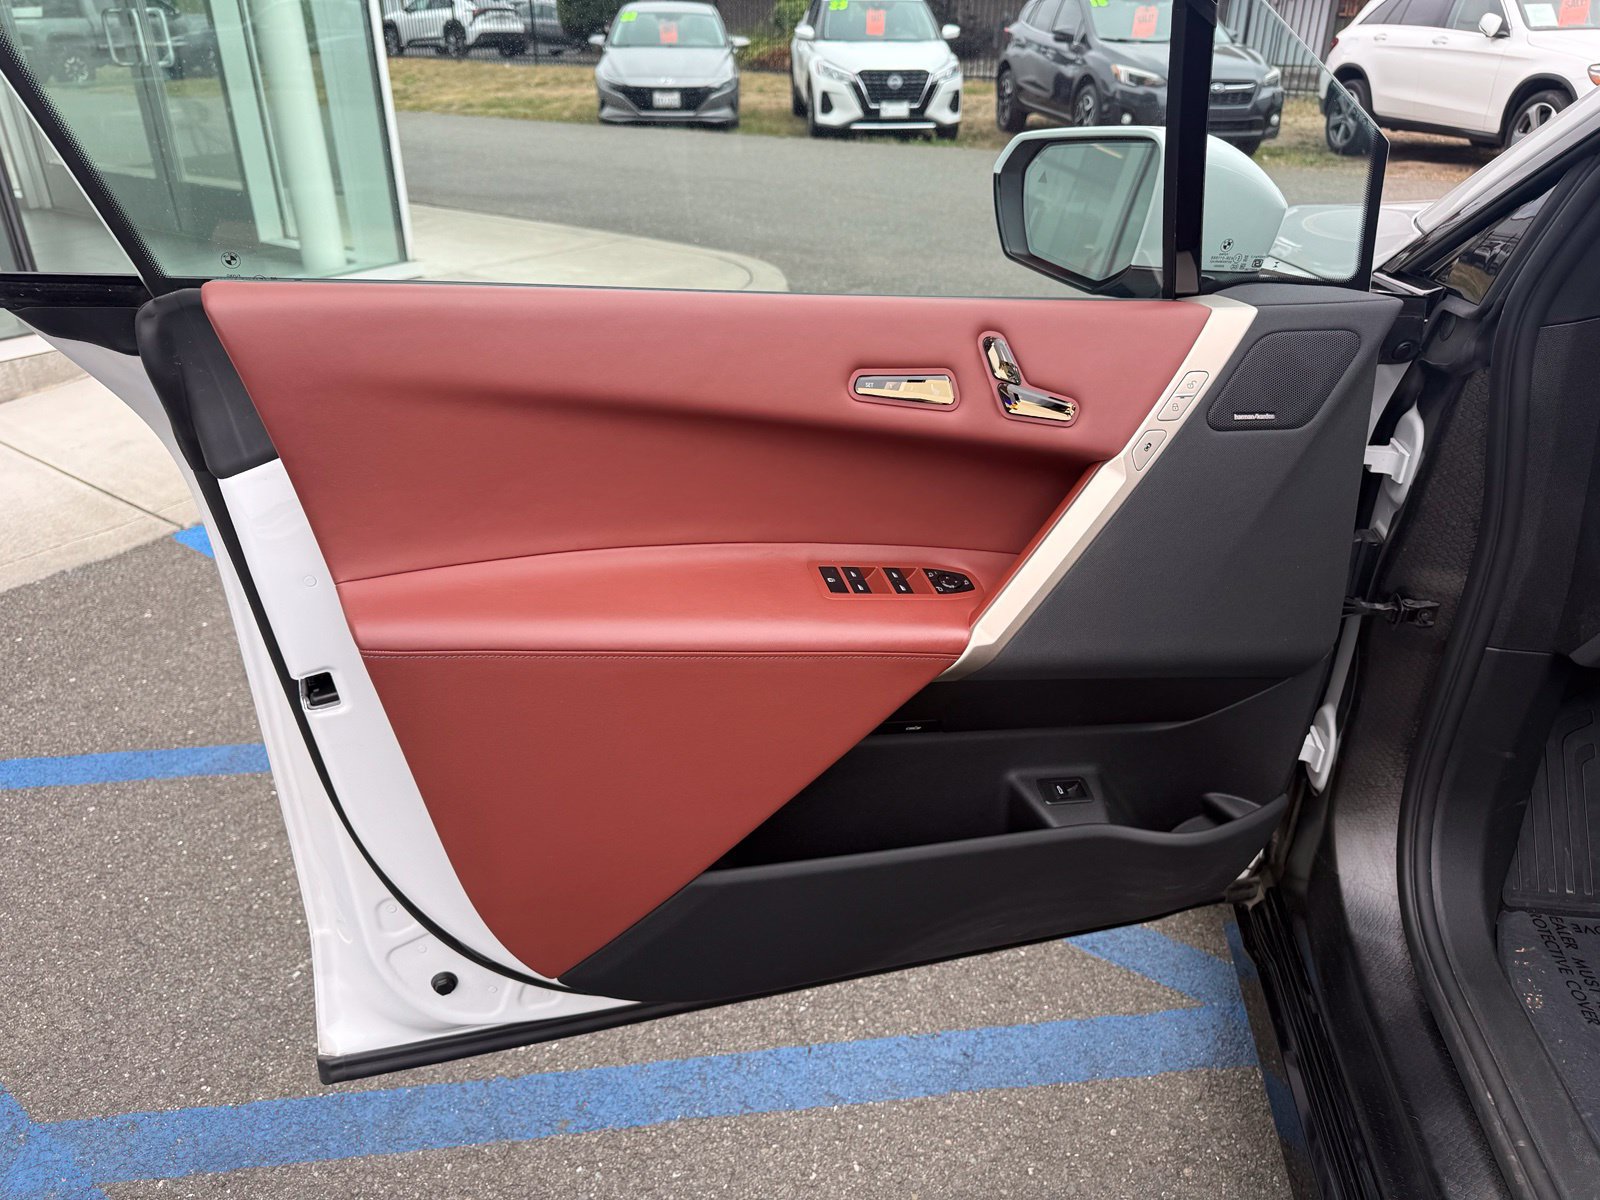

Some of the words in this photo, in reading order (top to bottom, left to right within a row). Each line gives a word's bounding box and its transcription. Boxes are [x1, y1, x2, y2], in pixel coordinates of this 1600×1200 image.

[1549, 916, 1579, 950] EALER
[1530, 914, 1575, 976] OTECTIVE
[1566, 980, 1600, 1026] COVER
